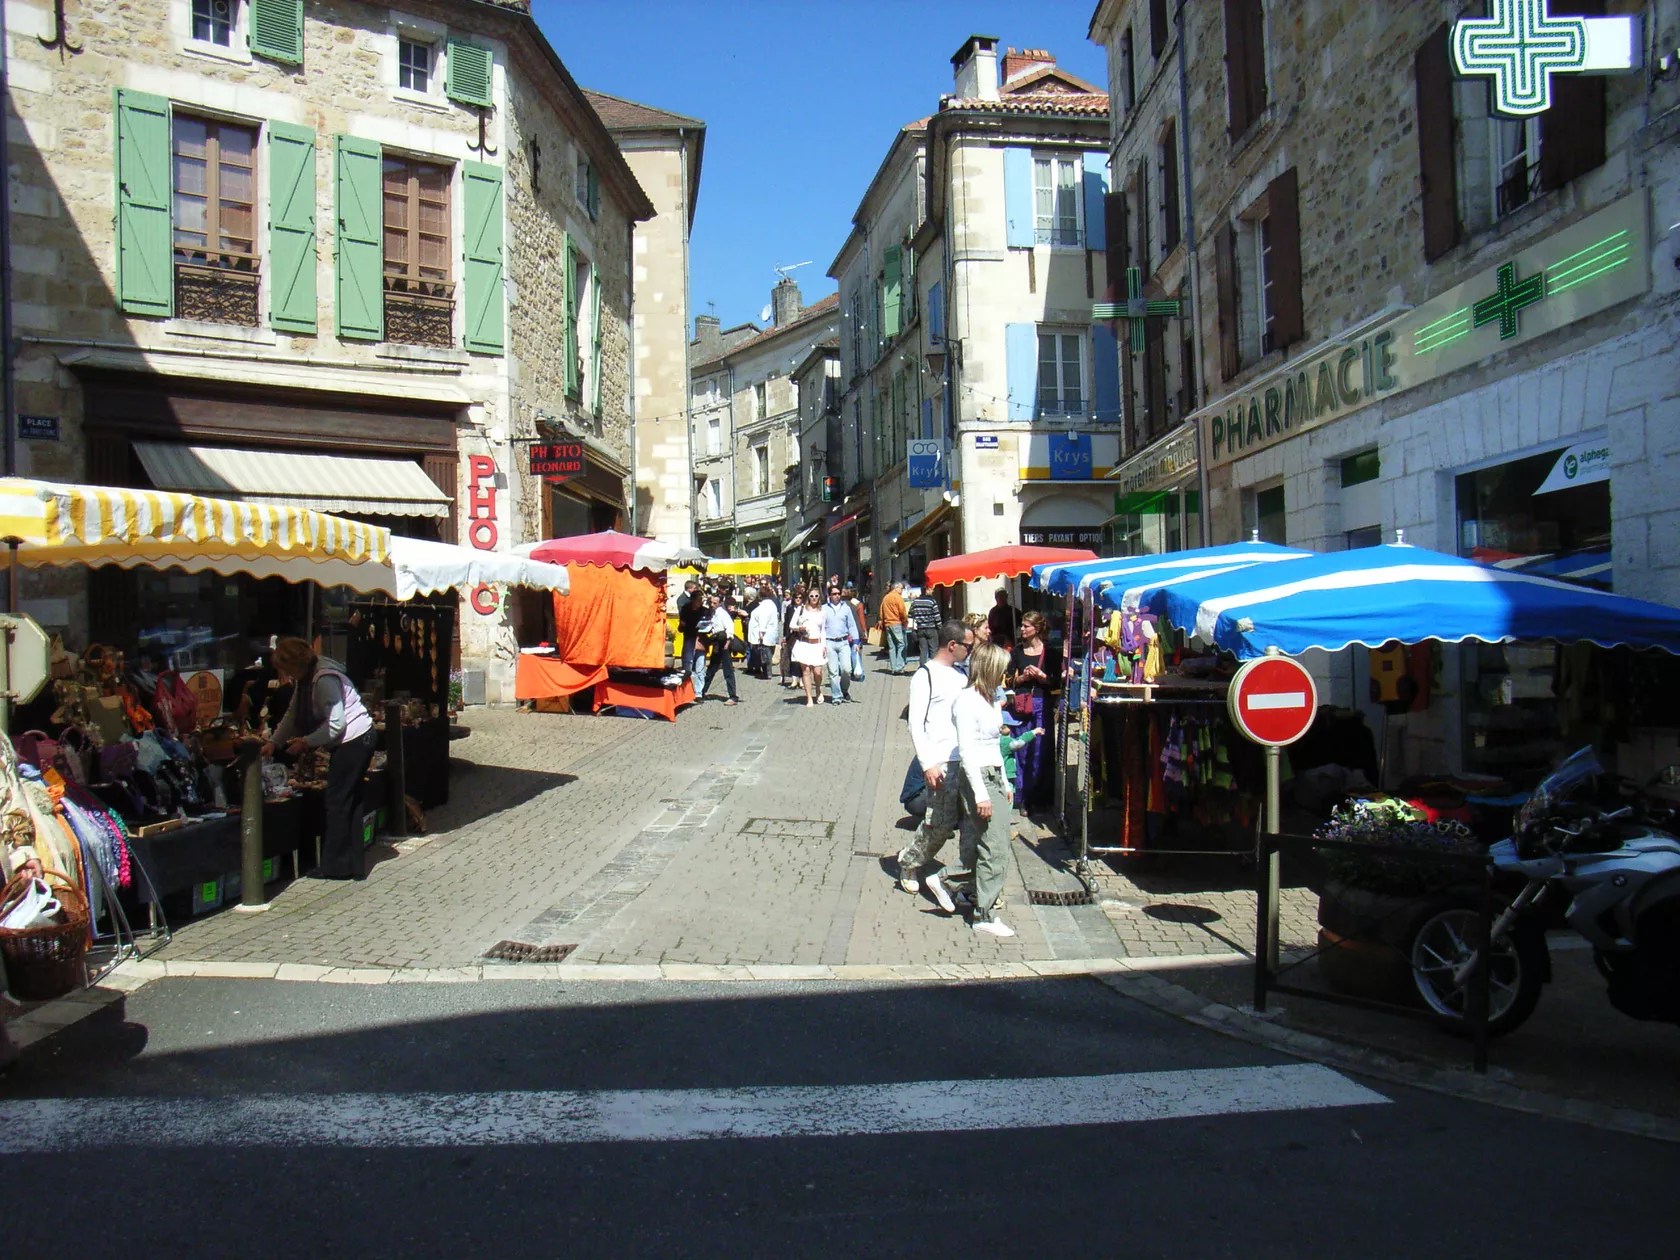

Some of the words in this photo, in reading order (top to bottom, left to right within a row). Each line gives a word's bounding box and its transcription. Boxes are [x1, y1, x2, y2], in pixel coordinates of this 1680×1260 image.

[1211, 330, 1396, 461] PHARMACIE
[26, 418, 52, 427] PLACE
[1054, 449, 1090, 466] Krys
[468, 454, 499, 616] PHOO
[1024, 533, 1044, 543] TIERS
[1049, 533, 1074, 543] PAYANT
